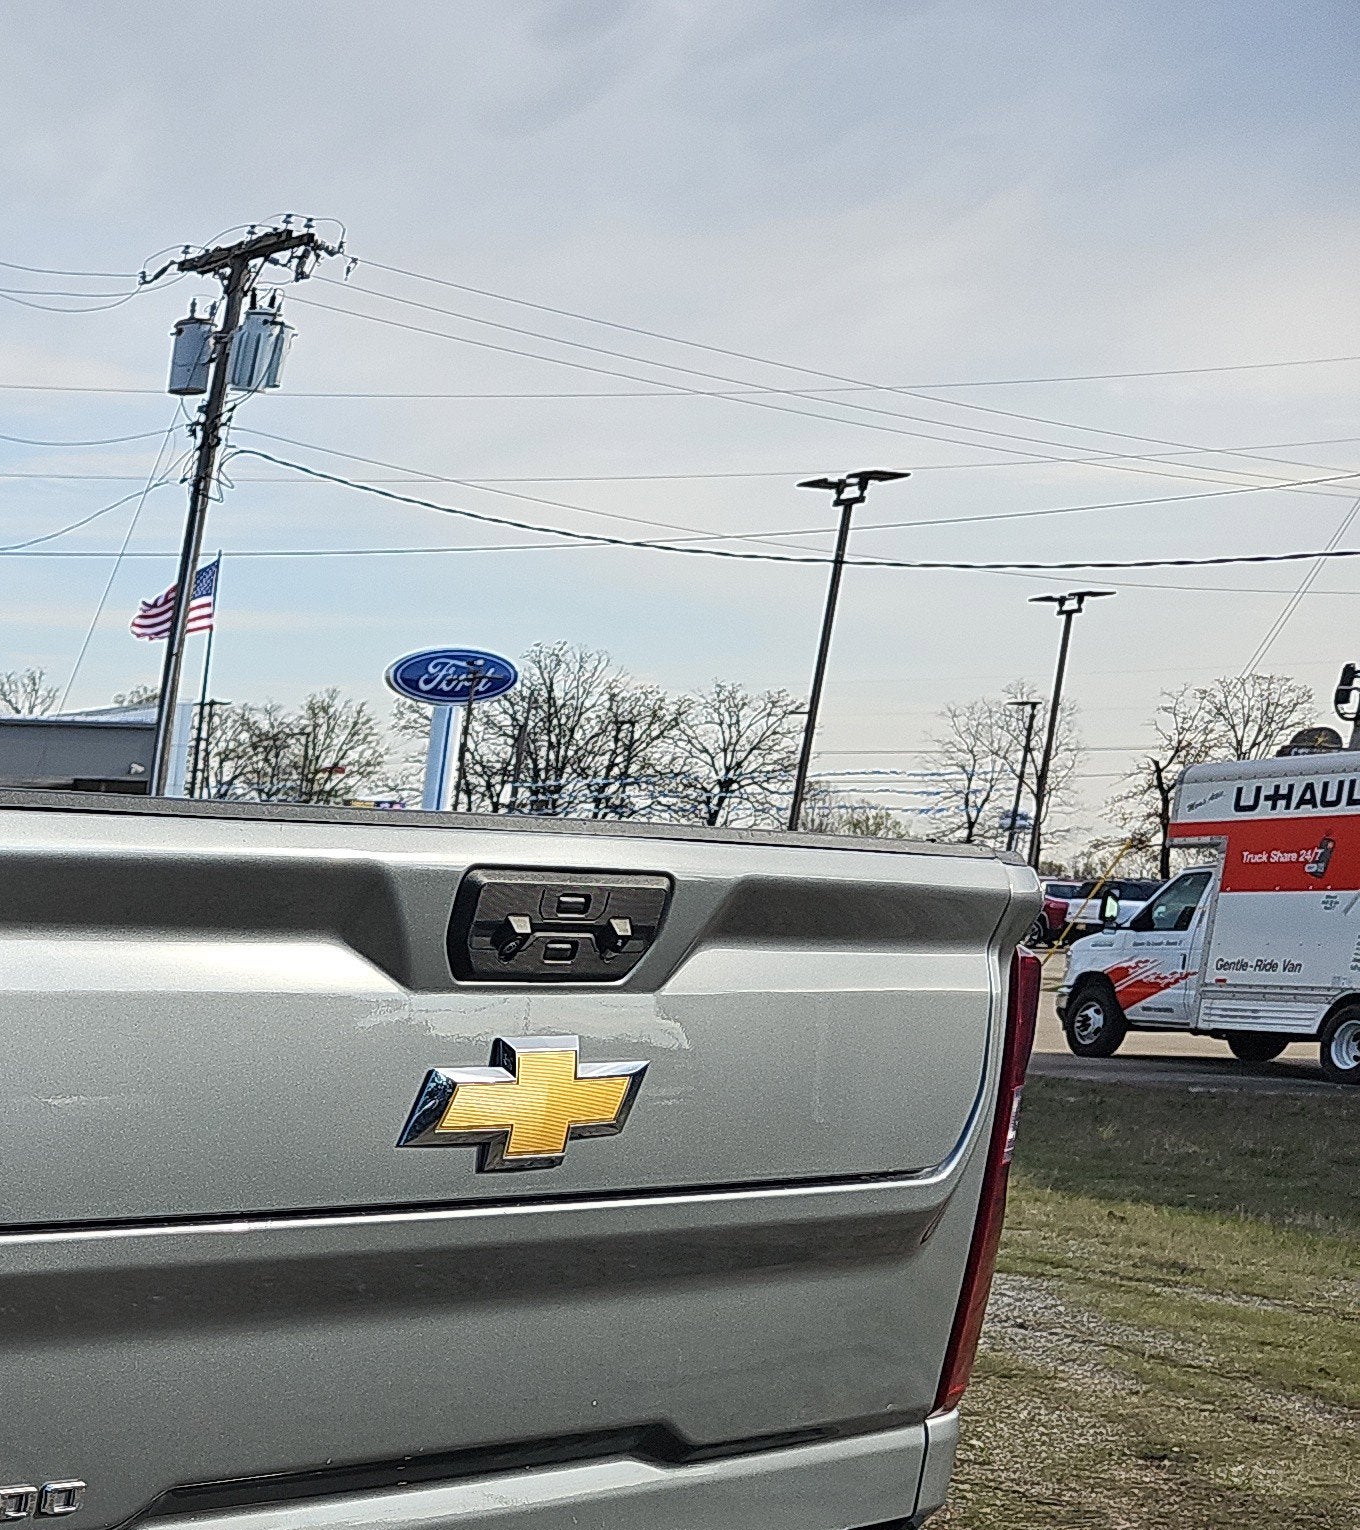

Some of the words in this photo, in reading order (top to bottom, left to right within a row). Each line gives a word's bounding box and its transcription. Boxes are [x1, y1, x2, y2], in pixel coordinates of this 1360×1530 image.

[418, 657, 495, 692] Ford
[1233, 778, 1360, 813] U-HAUL
[1242, 851, 1268, 863] Truck
[1270, 850, 1298, 863] Share
[1299, 847, 1324, 862] 24/7
[1215, 957, 1279, 973] Gentle-Ride
[1282, 959, 1303, 974] Van
